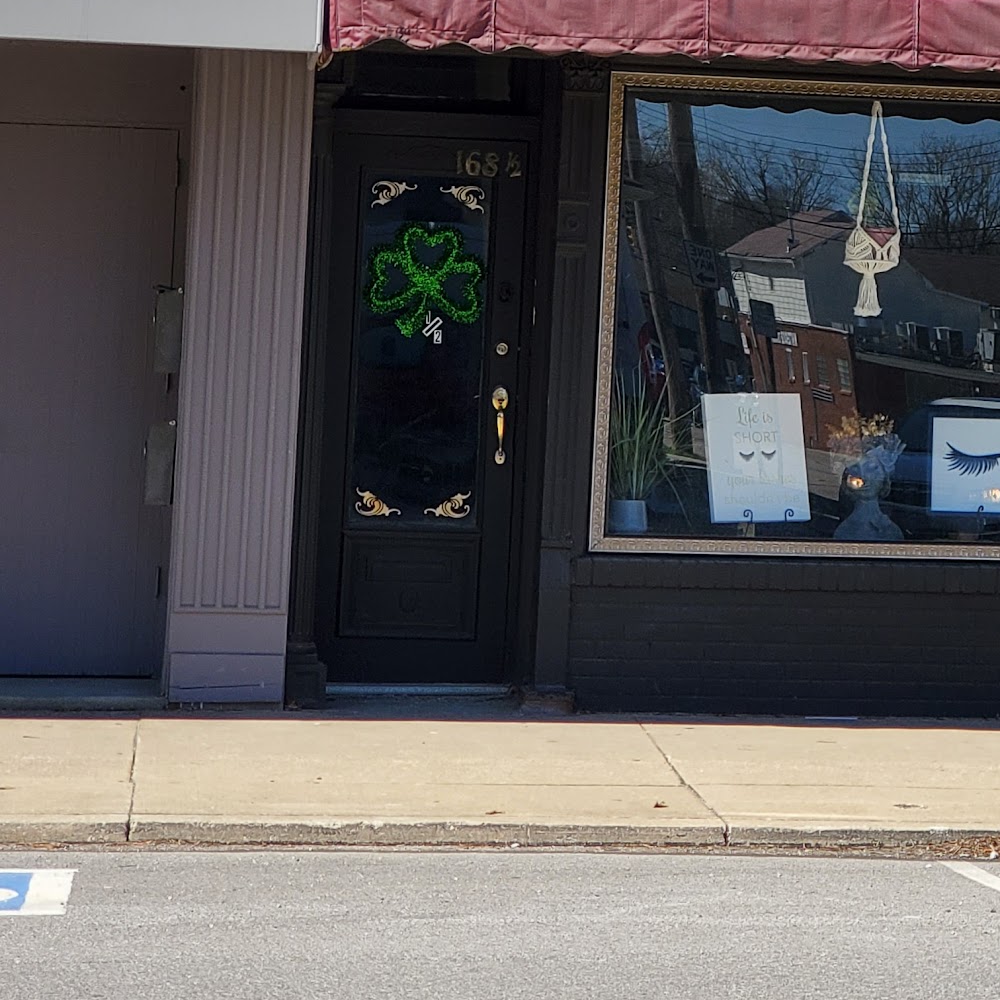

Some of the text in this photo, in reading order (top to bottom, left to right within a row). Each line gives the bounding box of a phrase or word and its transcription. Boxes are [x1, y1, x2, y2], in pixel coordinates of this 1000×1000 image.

[457, 150, 499, 177] 168
[737, 406, 774, 428] Life is
[734, 431, 778, 444] SHORT
